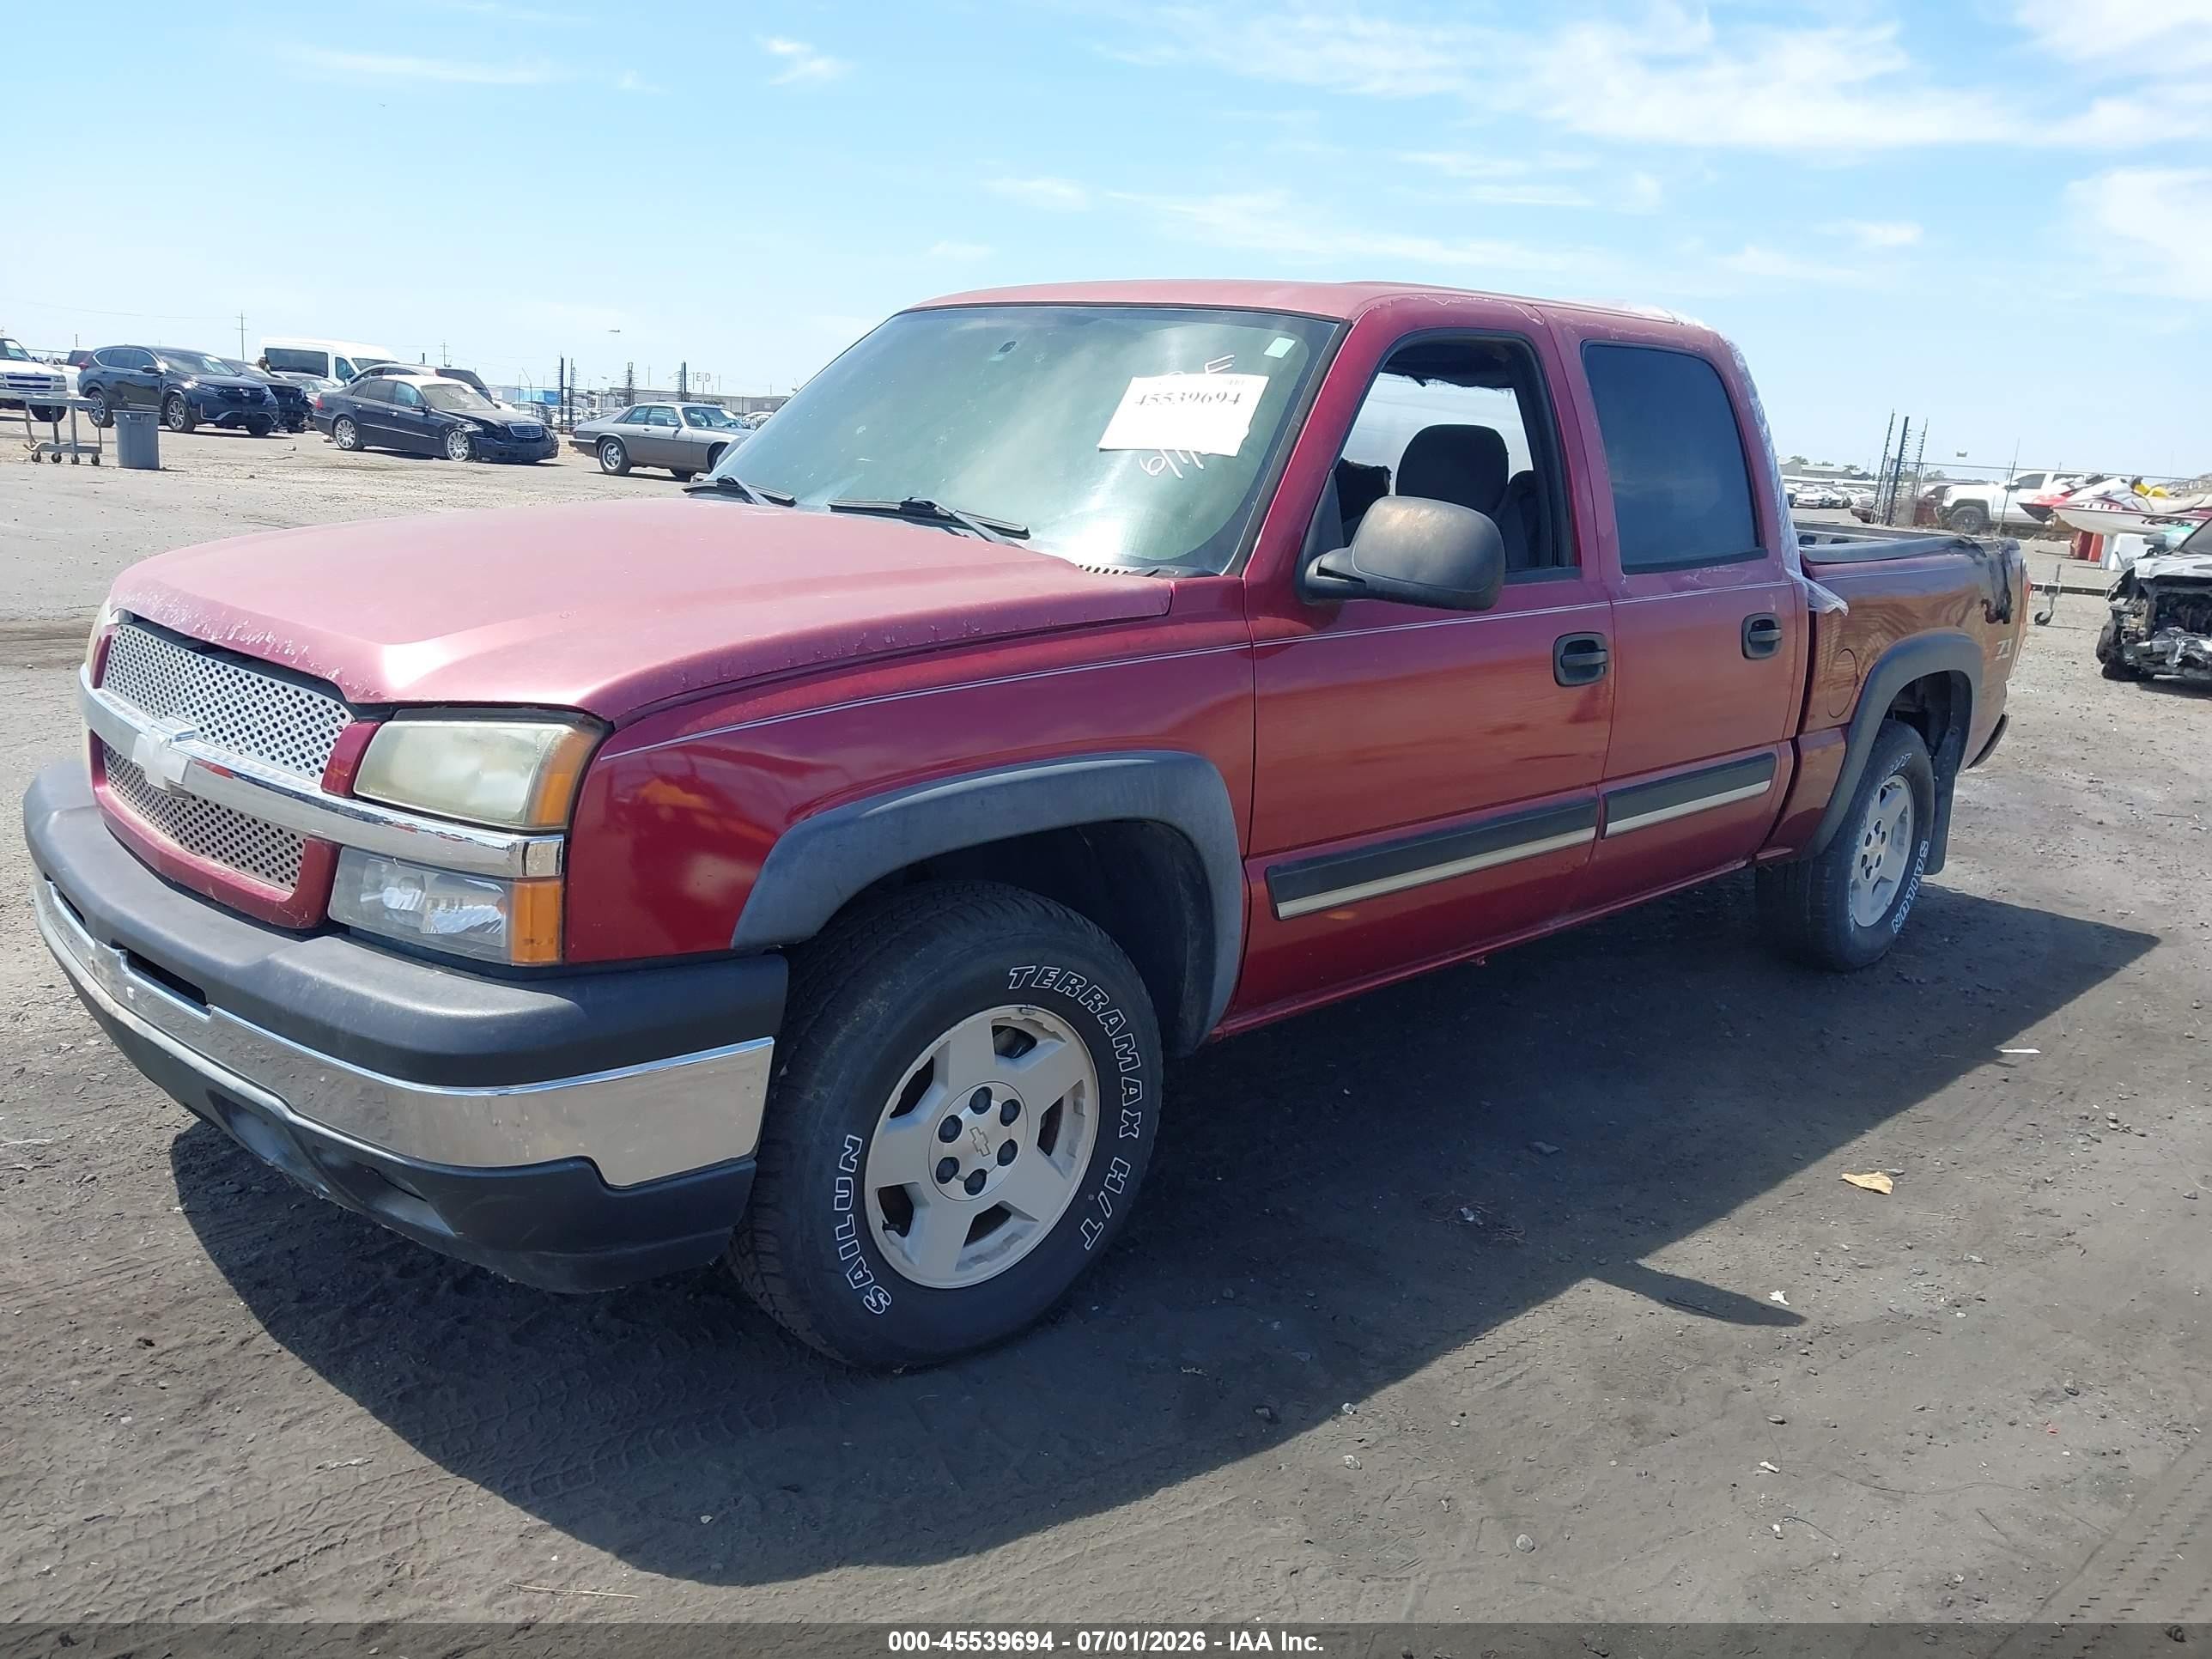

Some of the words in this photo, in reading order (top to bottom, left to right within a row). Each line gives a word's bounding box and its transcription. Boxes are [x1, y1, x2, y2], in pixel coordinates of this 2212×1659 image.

[1891, 840, 1929, 934] SAILUN
[1007, 964, 1144, 1139] TERRAMAX
[1078, 1157, 1132, 1250] H/T
[834, 1133, 892, 1315] SAILUN
